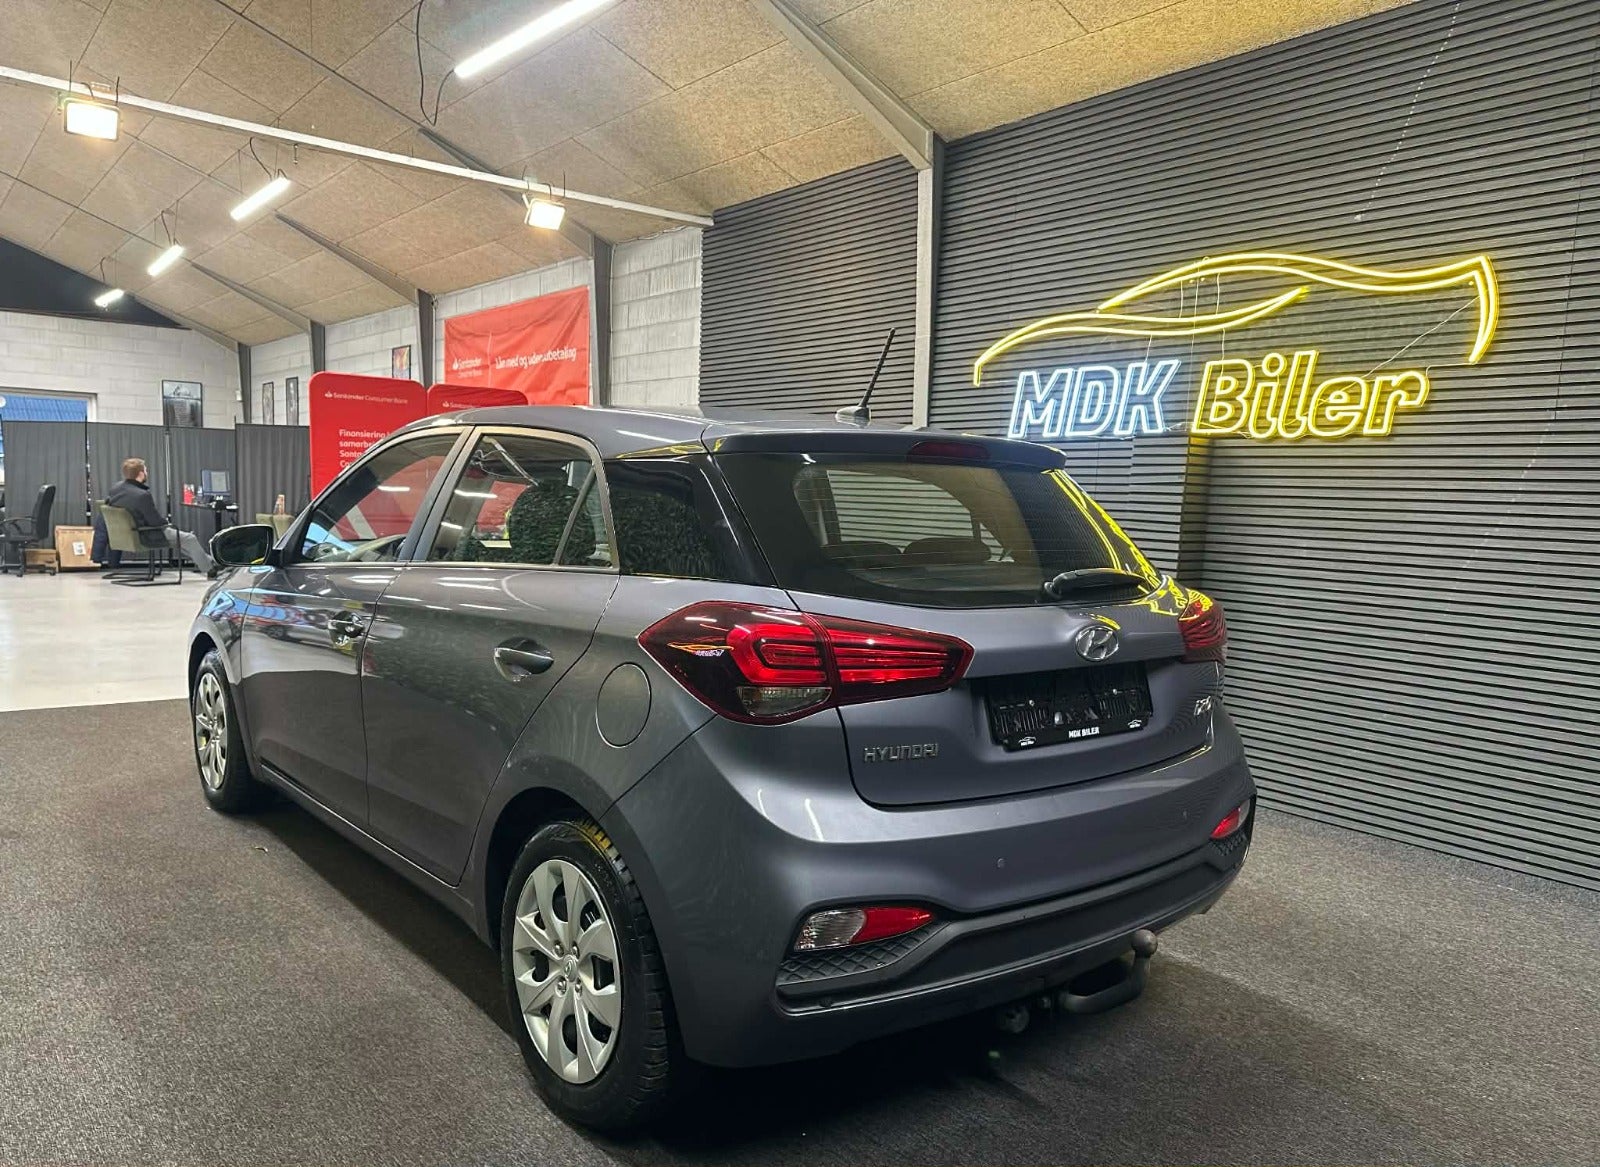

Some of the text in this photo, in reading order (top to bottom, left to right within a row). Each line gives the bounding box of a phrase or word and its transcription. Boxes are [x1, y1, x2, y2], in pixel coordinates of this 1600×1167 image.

[505, 354, 519, 368] med
[519, 356, 528, 369] og
[333, 392, 364, 401] Santander
[365, 395, 393, 403] Consumer
[1007, 349, 1430, 439] MDK Biler
[339, 429, 386, 439] Finansiering
[1068, 726, 1100, 738] MDK BILER
[864, 743, 938, 762] HYUNDAI
